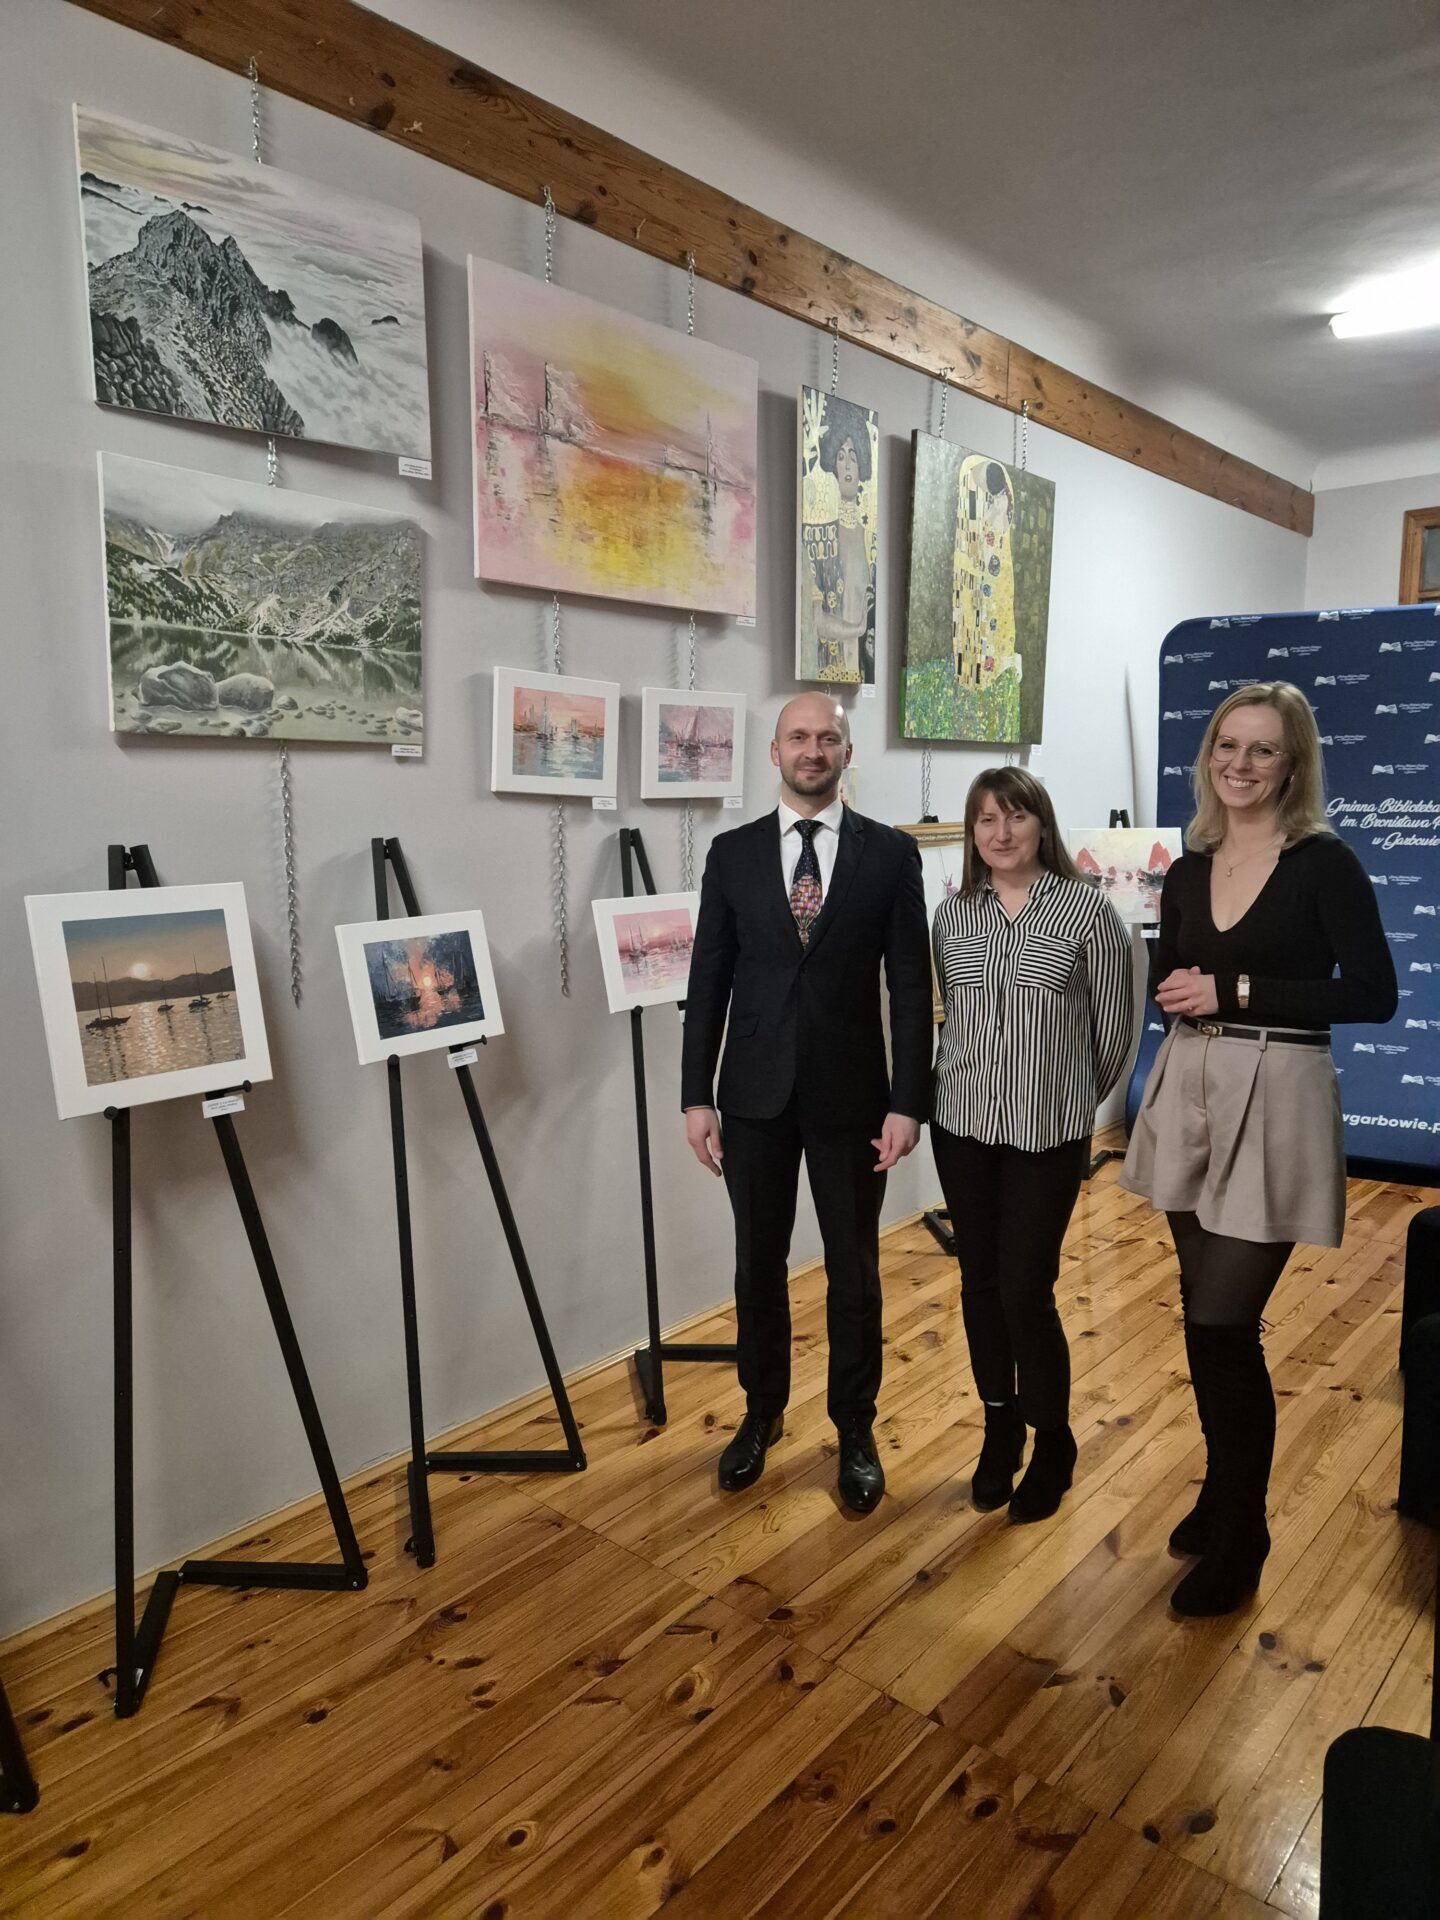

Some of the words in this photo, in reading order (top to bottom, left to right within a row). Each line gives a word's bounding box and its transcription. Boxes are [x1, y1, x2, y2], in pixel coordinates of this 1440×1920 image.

[1325, 798, 1377, 817] Gminna
[1378, 798, 1440, 814] Biblioteka
[1340, 815, 1357, 827] im.
[1360, 813, 1431, 828] Bronisława
[1372, 837, 1384, 845] w
[1382, 832, 1440, 850] Garbowie
